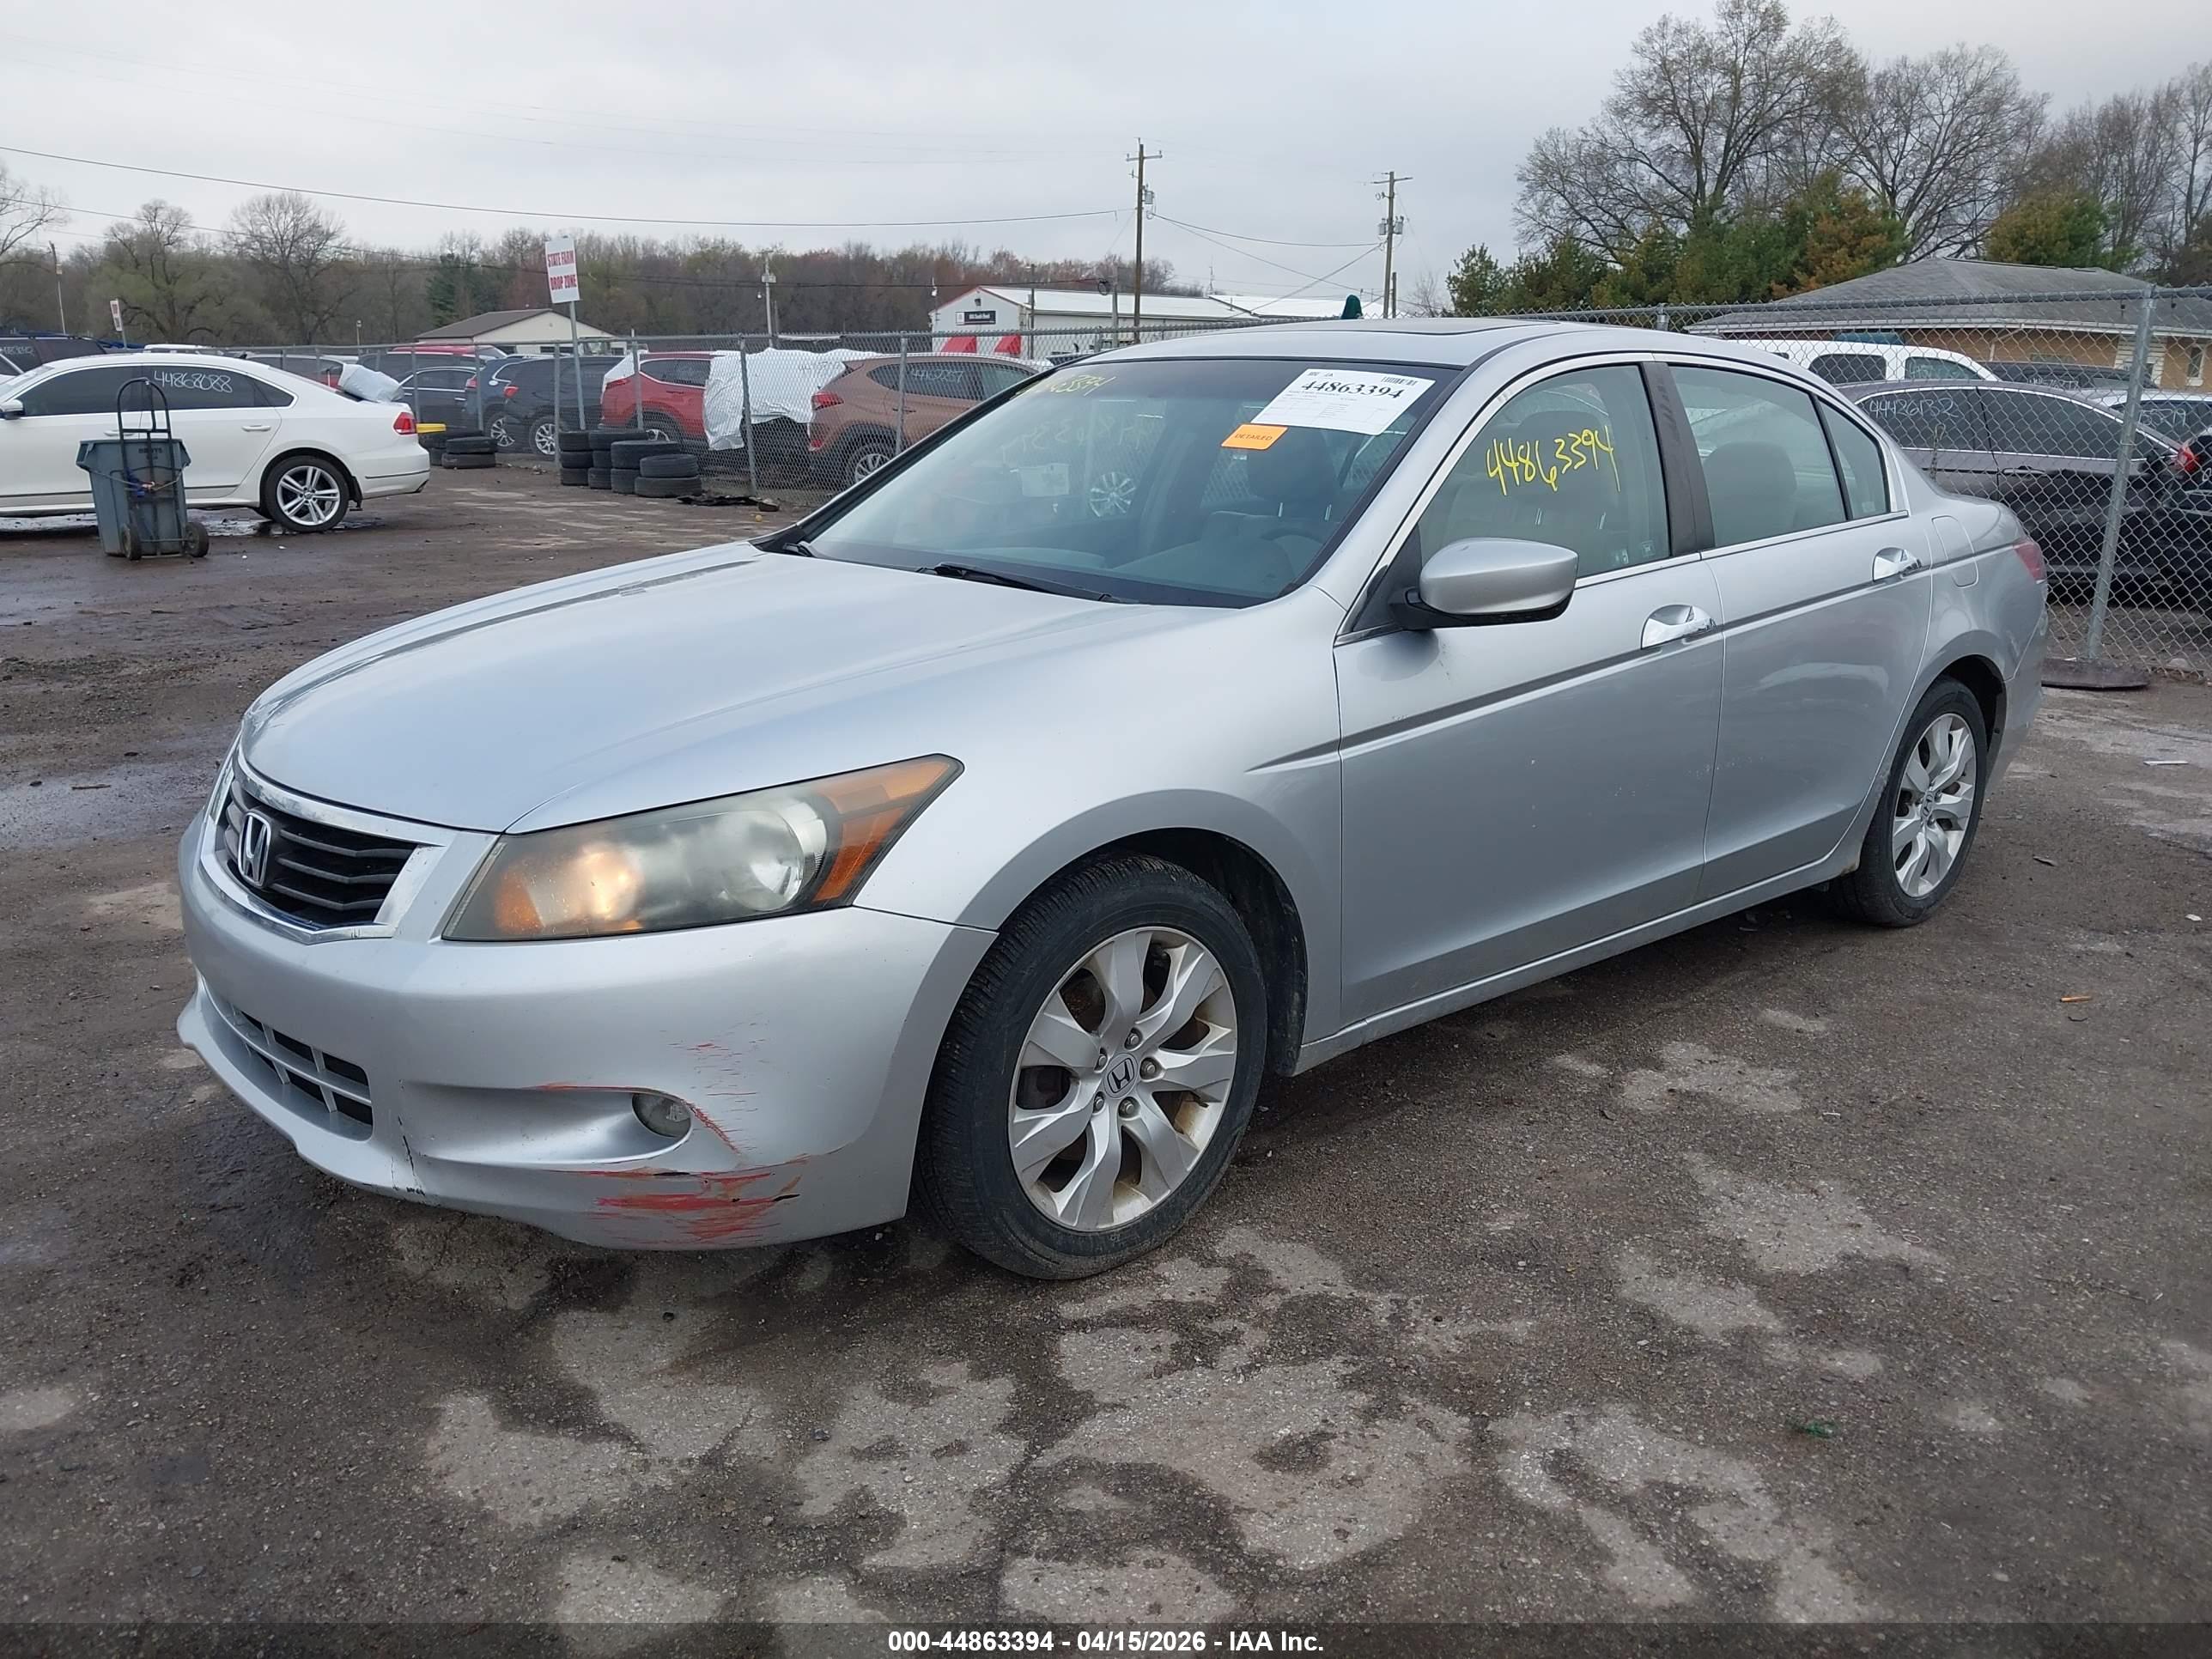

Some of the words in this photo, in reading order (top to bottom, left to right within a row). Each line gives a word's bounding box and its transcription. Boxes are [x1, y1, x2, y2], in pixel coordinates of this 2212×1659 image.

[547, 252, 562, 268] STATE
[561, 250, 574, 265] FARM
[550, 276, 563, 290] DROP
[563, 274, 577, 289] ZONE
[154, 370, 233, 393] 44868088
[1301, 380, 1406, 399] 44863394
[1234, 433, 1273, 441] DETAILED
[1486, 424, 1621, 496] 44863394
